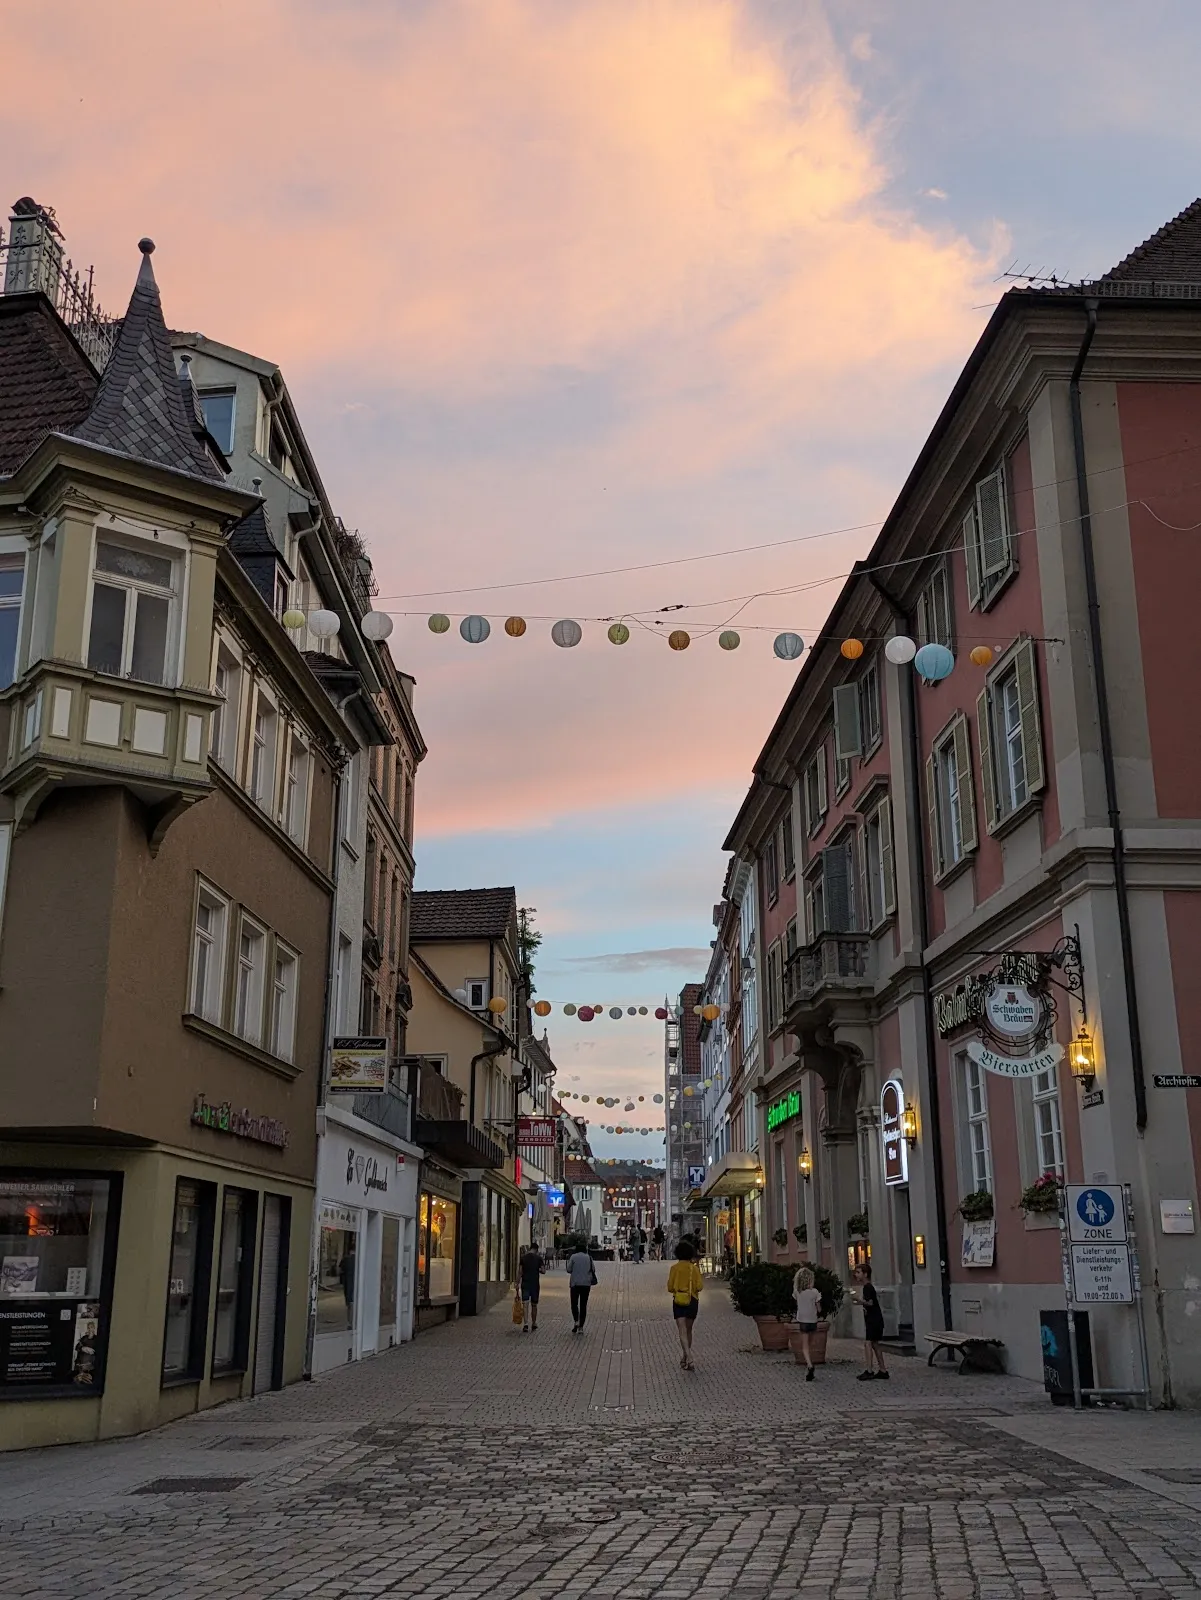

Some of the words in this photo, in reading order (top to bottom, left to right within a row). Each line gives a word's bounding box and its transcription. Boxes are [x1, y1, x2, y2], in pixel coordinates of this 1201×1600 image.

[992, 1004, 1034, 1014] Schwaben
[1003, 1014, 1024, 1023] Bräu
[978, 1050, 1055, 1077] Biergarten
[1158, 1076, 1199, 1087] Archivstr.
[1084, 1229, 1113, 1239] ZONE
[1082, 1247, 1104, 1255] Liefer-
[1105, 1247, 1117, 1255] und
[1076, 1255, 1124, 1265] Dienstleistungs-
